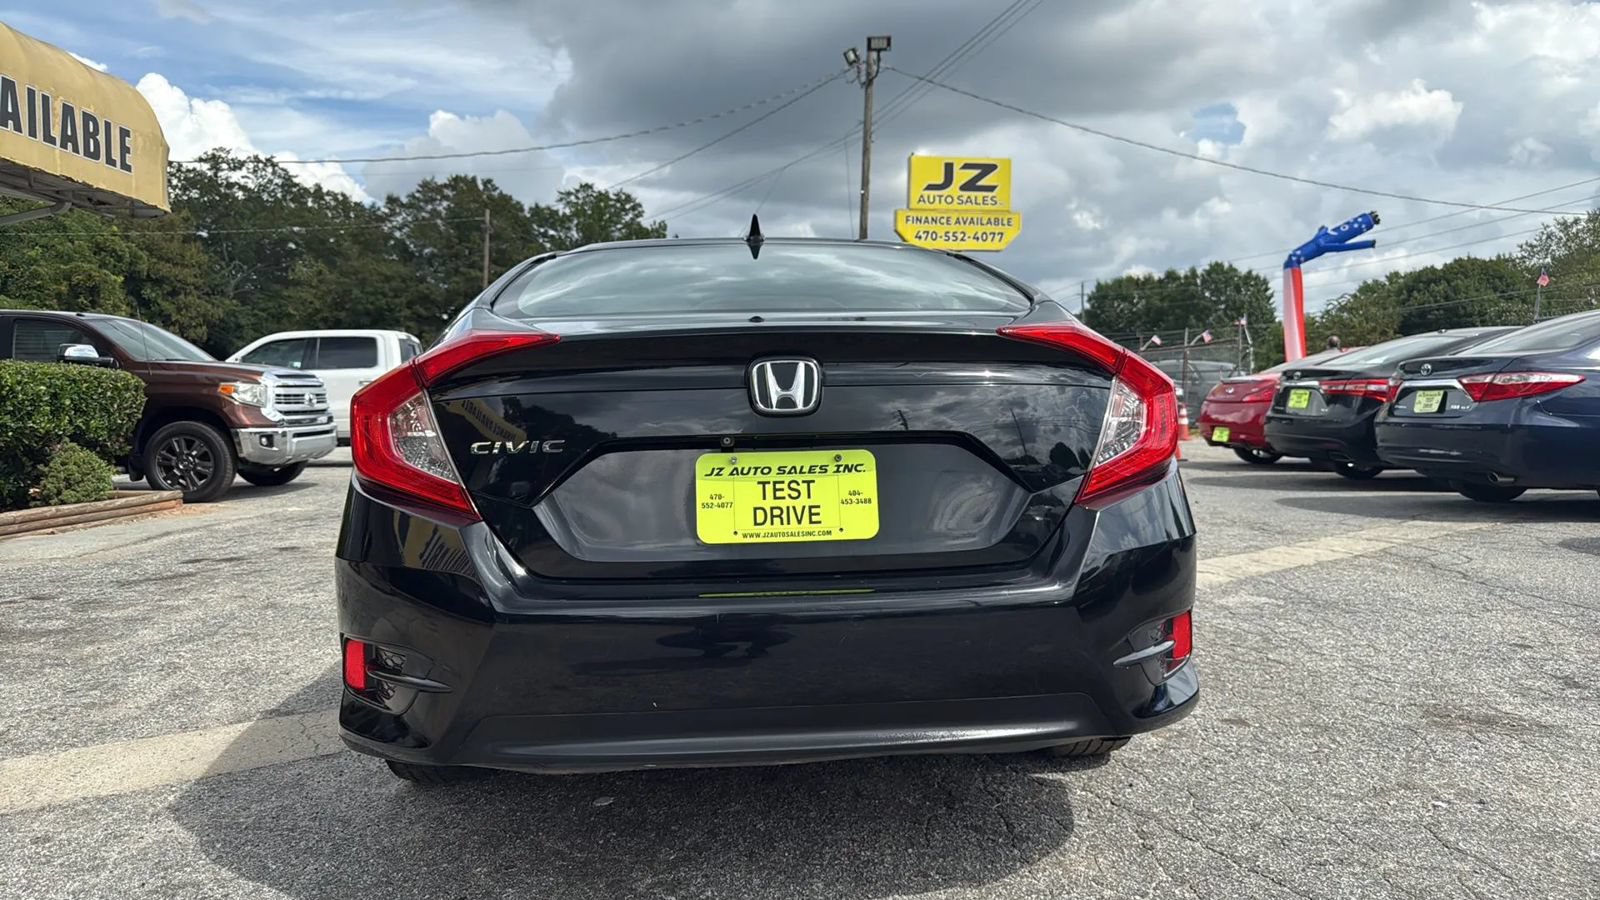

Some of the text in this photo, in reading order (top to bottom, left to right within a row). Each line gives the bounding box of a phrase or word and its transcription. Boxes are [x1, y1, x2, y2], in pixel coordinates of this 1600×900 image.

[922, 162, 999, 193] JZ
[917, 194, 998, 206] AUTO SALES
[905, 215, 1013, 227] FINANCE AVAILABLE
[914, 230, 1005, 243] 470-552-4077
[470, 439, 566, 455] CIVIC
[704, 463, 866, 477] JZ AUTO SALES INC.
[757, 479, 816, 501] TEST
[701, 501, 734, 510] 552-4077
[753, 504, 823, 527] DRIVE
[742, 530, 833, 540] WWW.JZAUTOSALESINC.COM
